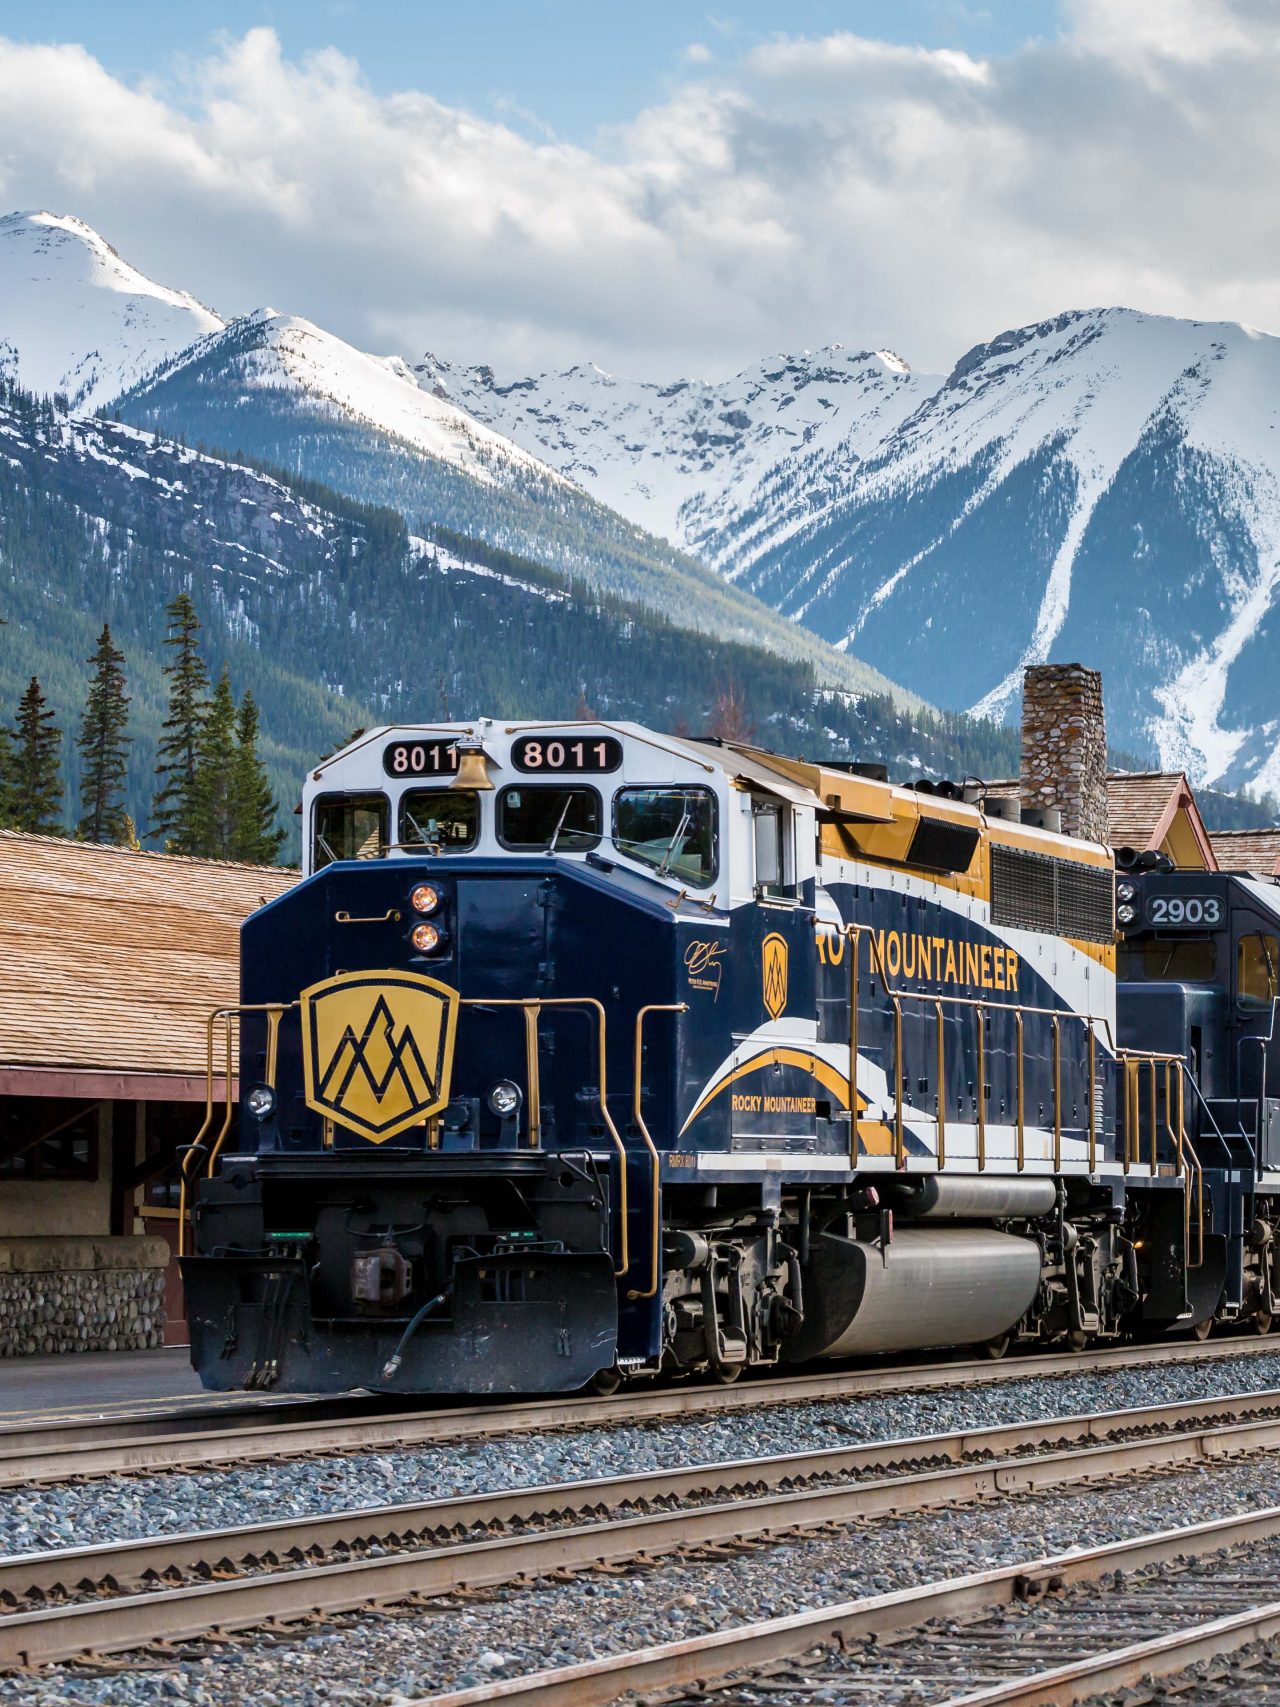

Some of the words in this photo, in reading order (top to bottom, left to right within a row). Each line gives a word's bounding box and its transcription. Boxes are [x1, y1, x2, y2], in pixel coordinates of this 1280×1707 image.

[393, 744, 458, 772] 8011
[523, 742, 607, 768] 8011
[1152, 899, 1220, 923] 2903
[869, 928, 1019, 992] MOUNTAINEER
[732, 1094, 762, 1112] ROCKY
[763, 1096, 817, 1113] MOUNTAINEER
